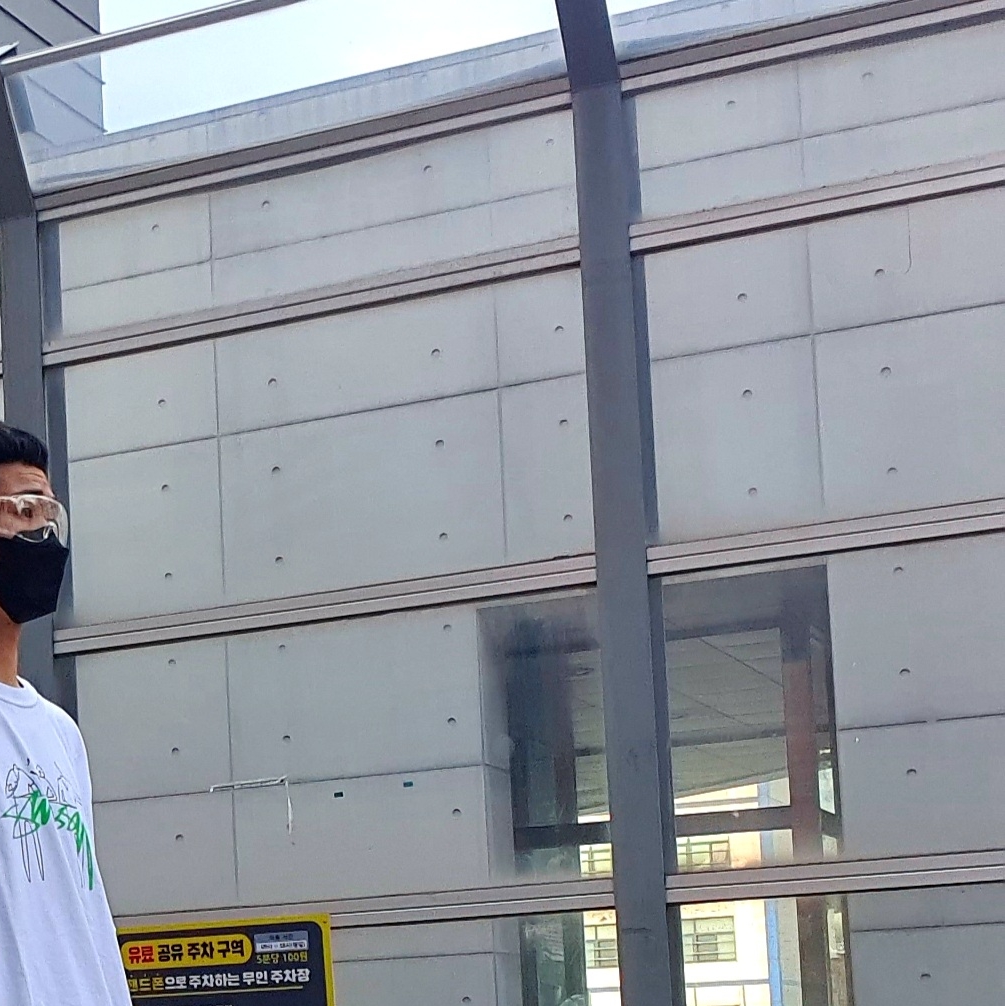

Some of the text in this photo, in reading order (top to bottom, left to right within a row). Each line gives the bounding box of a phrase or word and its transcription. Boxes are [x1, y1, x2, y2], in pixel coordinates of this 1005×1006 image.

[128, 945, 155, 964] 유료
[158, 944, 183, 962] 공유
[187, 941, 214, 960] 주차
[217, 940, 244, 957] 구역
[256, 951, 308, 964] 5분당 100원
[128, 968, 310, 992] 핸드폰으로 주차하는 무인 주차장
